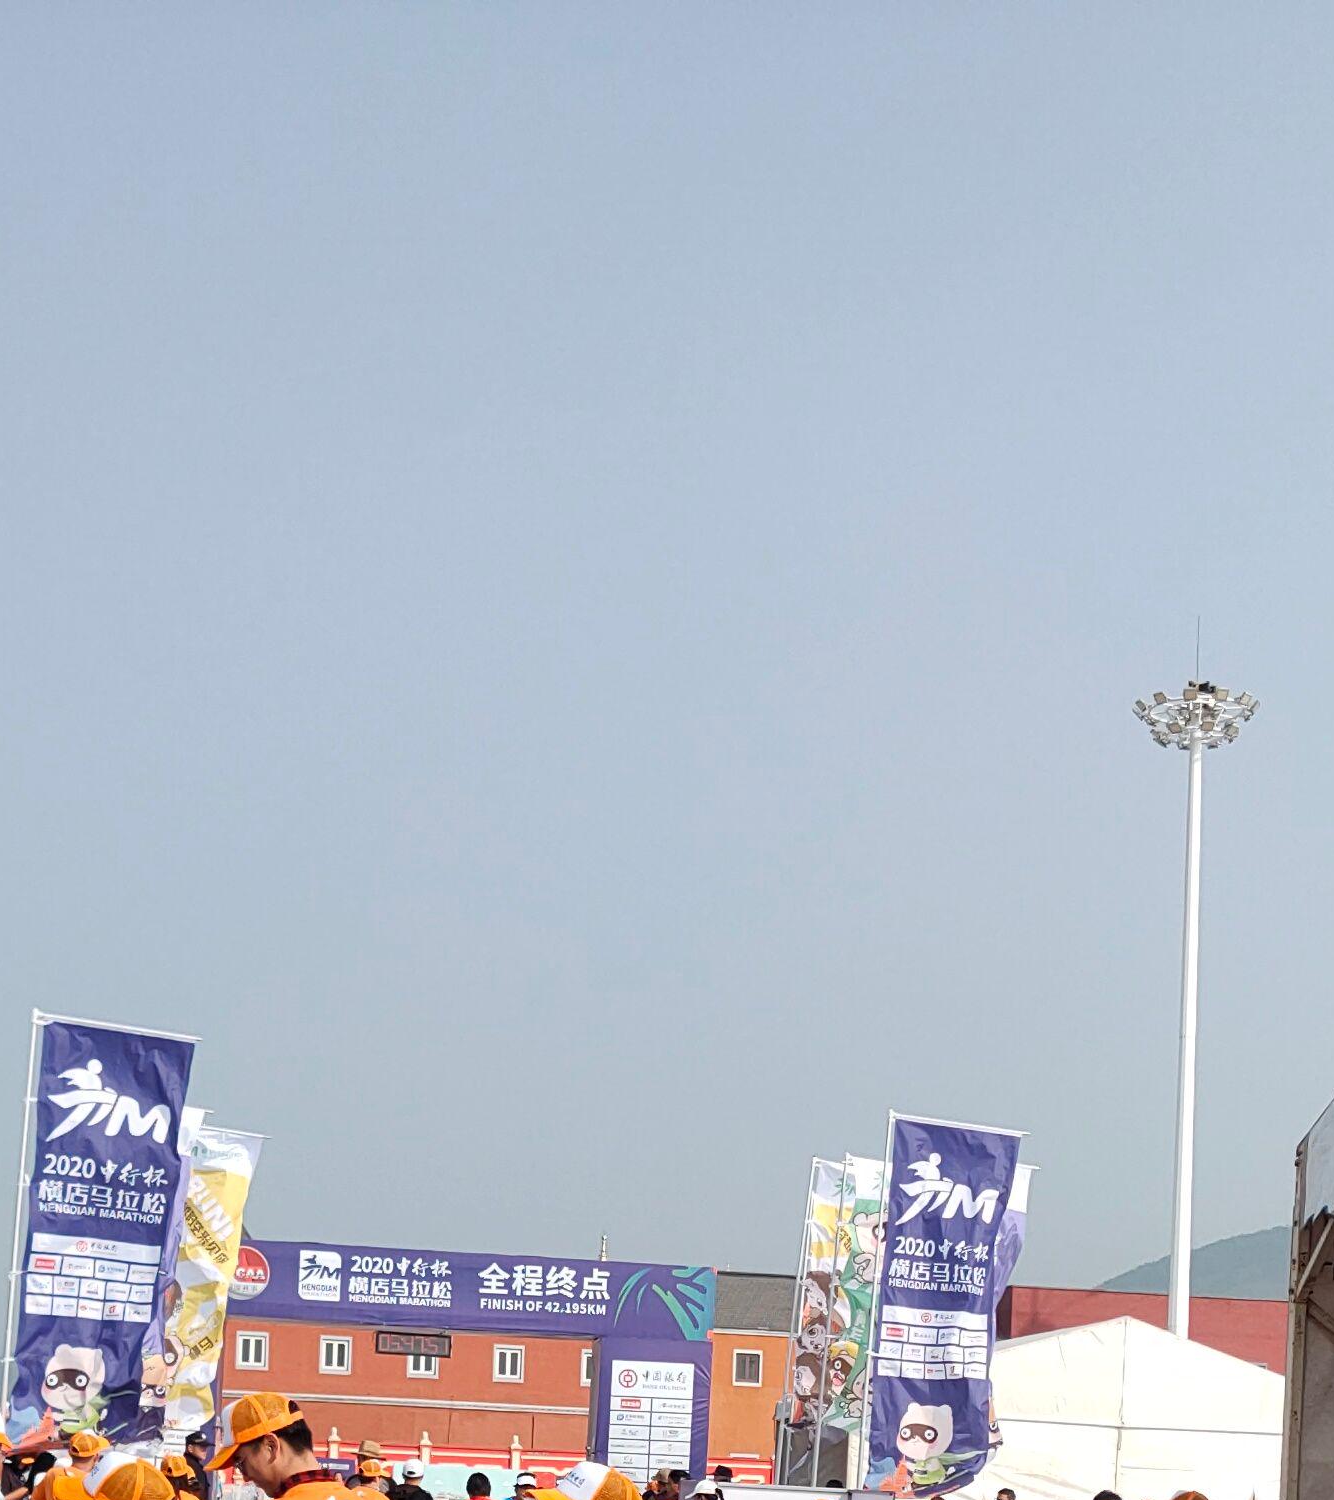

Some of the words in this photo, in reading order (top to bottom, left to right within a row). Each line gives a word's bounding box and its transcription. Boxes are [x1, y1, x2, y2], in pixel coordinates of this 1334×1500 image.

[43, 1154, 96, 1178] 2020
[101, 1159, 168, 1187] 中行杯
[38, 1179, 167, 1215] 横店马拉松
[39, 1202, 96, 1217] HENGDIAN
[99, 1208, 162, 1225] MARATHON
[894, 1236, 935, 1258] 2020
[351, 1256, 394, 1275] 2020
[397, 1257, 451, 1277] 中行杯
[888, 1258, 985, 1287] 横店马拉松
[348, 1276, 452, 1299] 横店马拉松
[478, 1262, 611, 1300] 全程终点
[888, 1278, 937, 1291] HENGDIAN
[349, 1294, 397, 1305] HENGDIAN
[399, 1297, 451, 1308] MARATHON
[480, 1298, 523, 1312] FINISH
[525, 1301, 543, 1312] OF
[545, 1302, 607, 1316] 42.195KM
